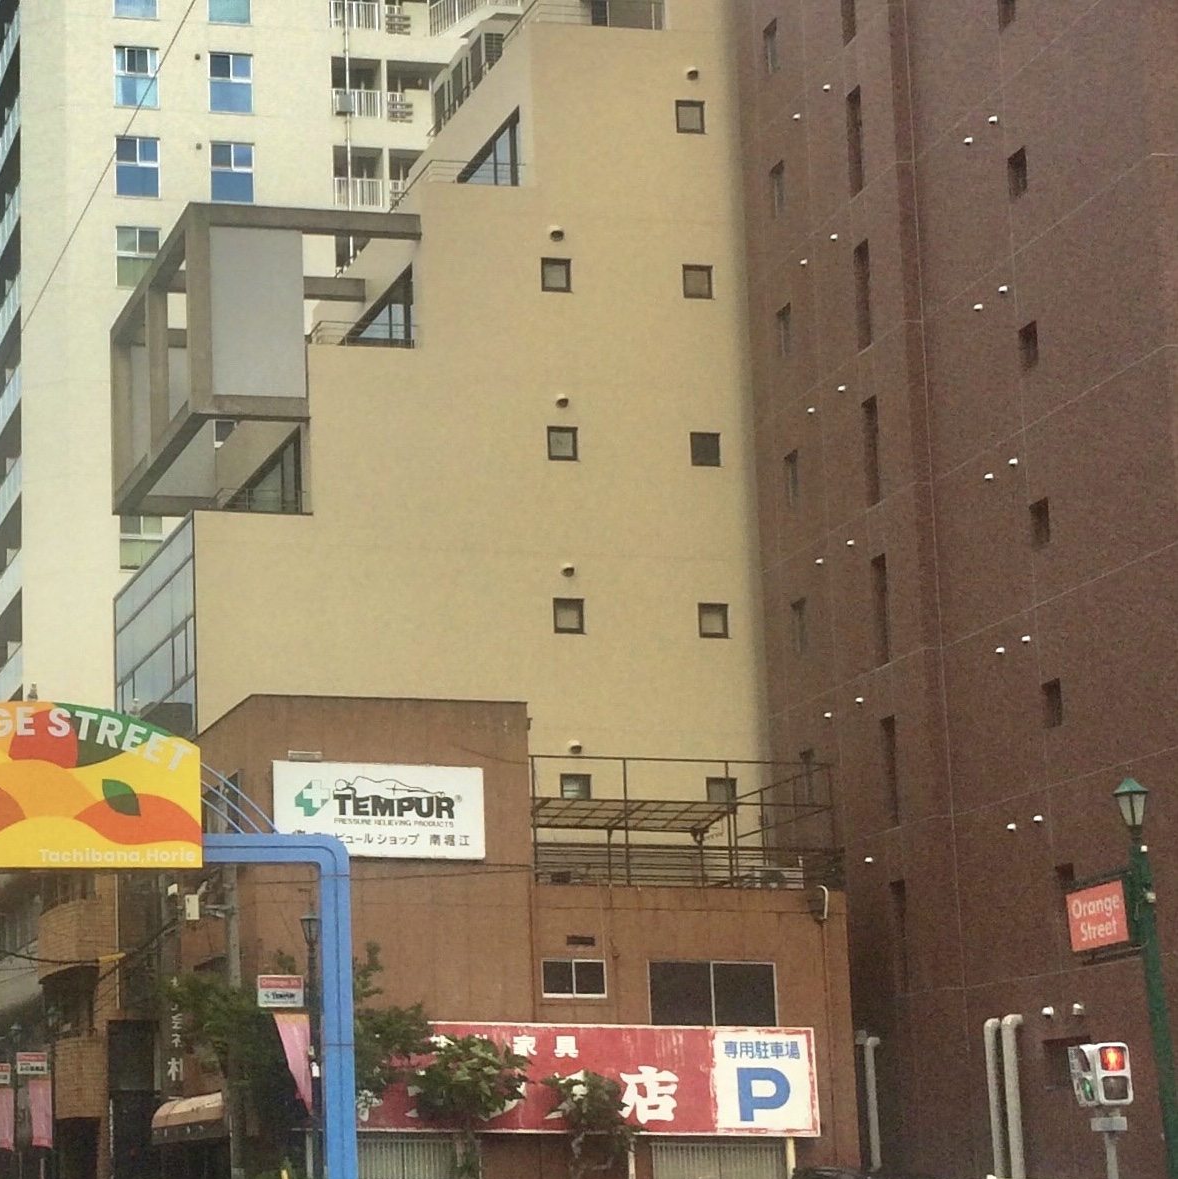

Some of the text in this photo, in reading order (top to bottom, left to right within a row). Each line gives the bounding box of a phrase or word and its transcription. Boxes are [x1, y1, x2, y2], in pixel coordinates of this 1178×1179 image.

[47, 709, 193, 772] STREET
[333, 793, 455, 819] TEMPUR
[334, 817, 454, 828] PRESSURE RELIEVING PRODUCTS
[429, 834, 471, 847] 南堀江
[1072, 894, 1119, 919] Orange
[1080, 916, 1117, 941] Street
[723, 1041, 800, 1059] 専用駐車場
[737, 1067, 791, 1122] P
